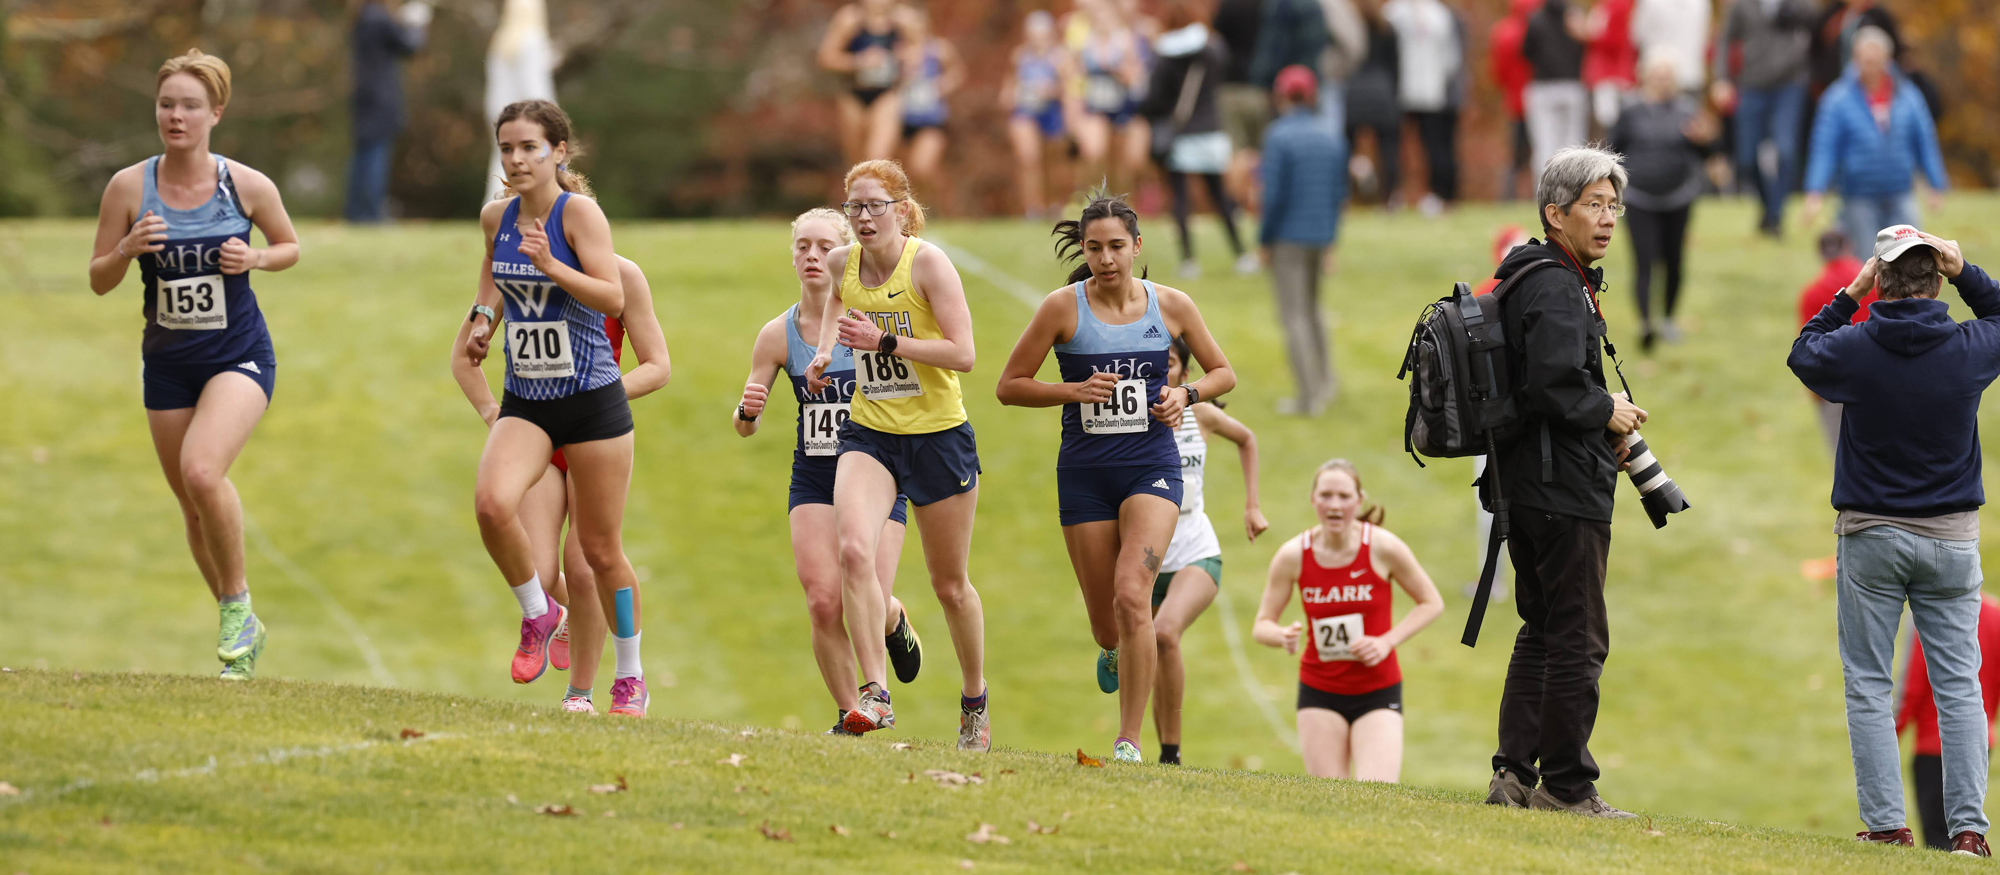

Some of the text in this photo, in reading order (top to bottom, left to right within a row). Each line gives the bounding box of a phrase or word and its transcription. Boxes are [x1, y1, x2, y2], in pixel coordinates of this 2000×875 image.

[155, 243, 221, 274] MHC
[163, 282, 214, 314] 153
[494, 279, 558, 319] W
[1582, 286, 1597, 314] Canon
[516, 328, 561, 360] 210
[861, 352, 909, 382] 186
[1091, 358, 1153, 381] MHC
[894, 382, 920, 393] Championships
[1094, 416, 1146, 428] Cross-Country Championships
[1302, 584, 1373, 604] CLARK
[1320, 623, 1349, 647] 24
